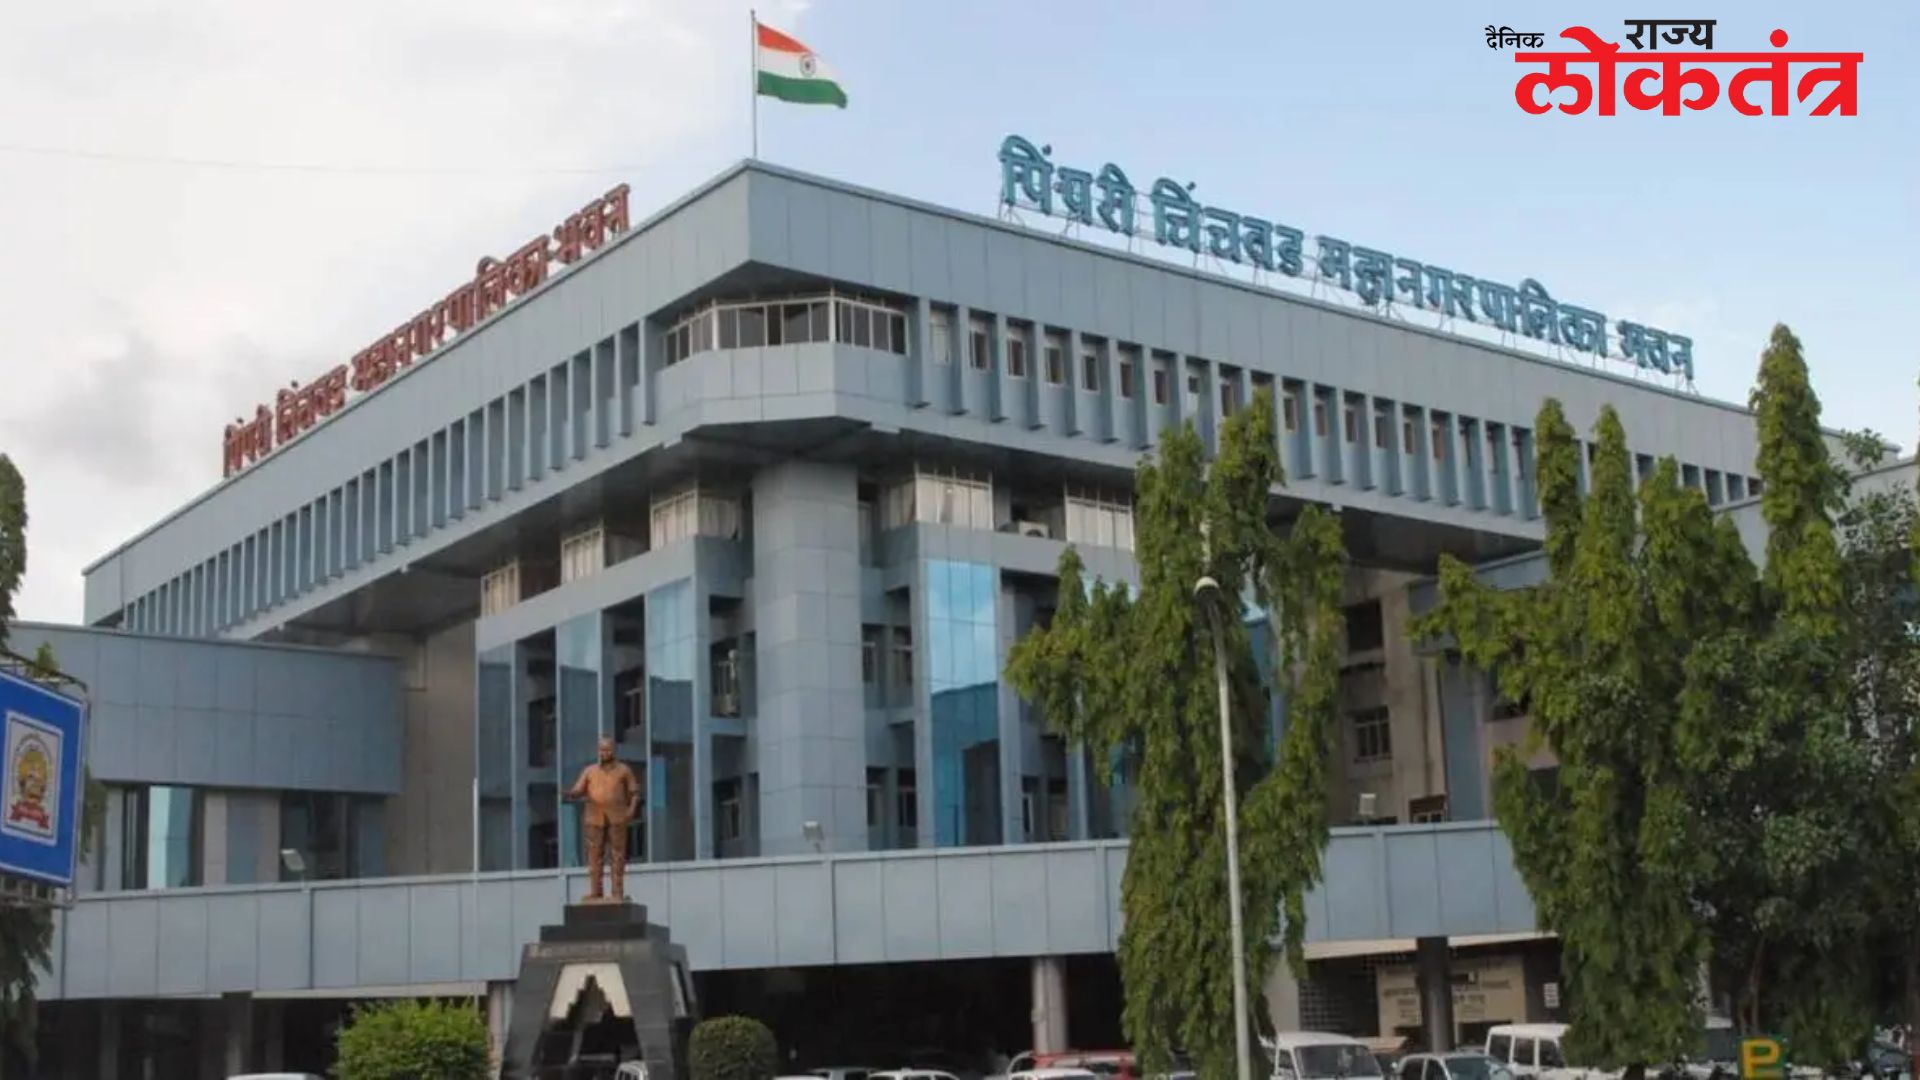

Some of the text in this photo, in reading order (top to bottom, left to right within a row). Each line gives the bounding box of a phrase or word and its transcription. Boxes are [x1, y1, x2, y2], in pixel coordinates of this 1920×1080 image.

[546, 182, 630, 265] भवन
[1150, 177, 1305, 277] चिंचवड
[1317, 234, 1608, 358] महानगरपालिका
[1616, 319, 1694, 381] भवन
